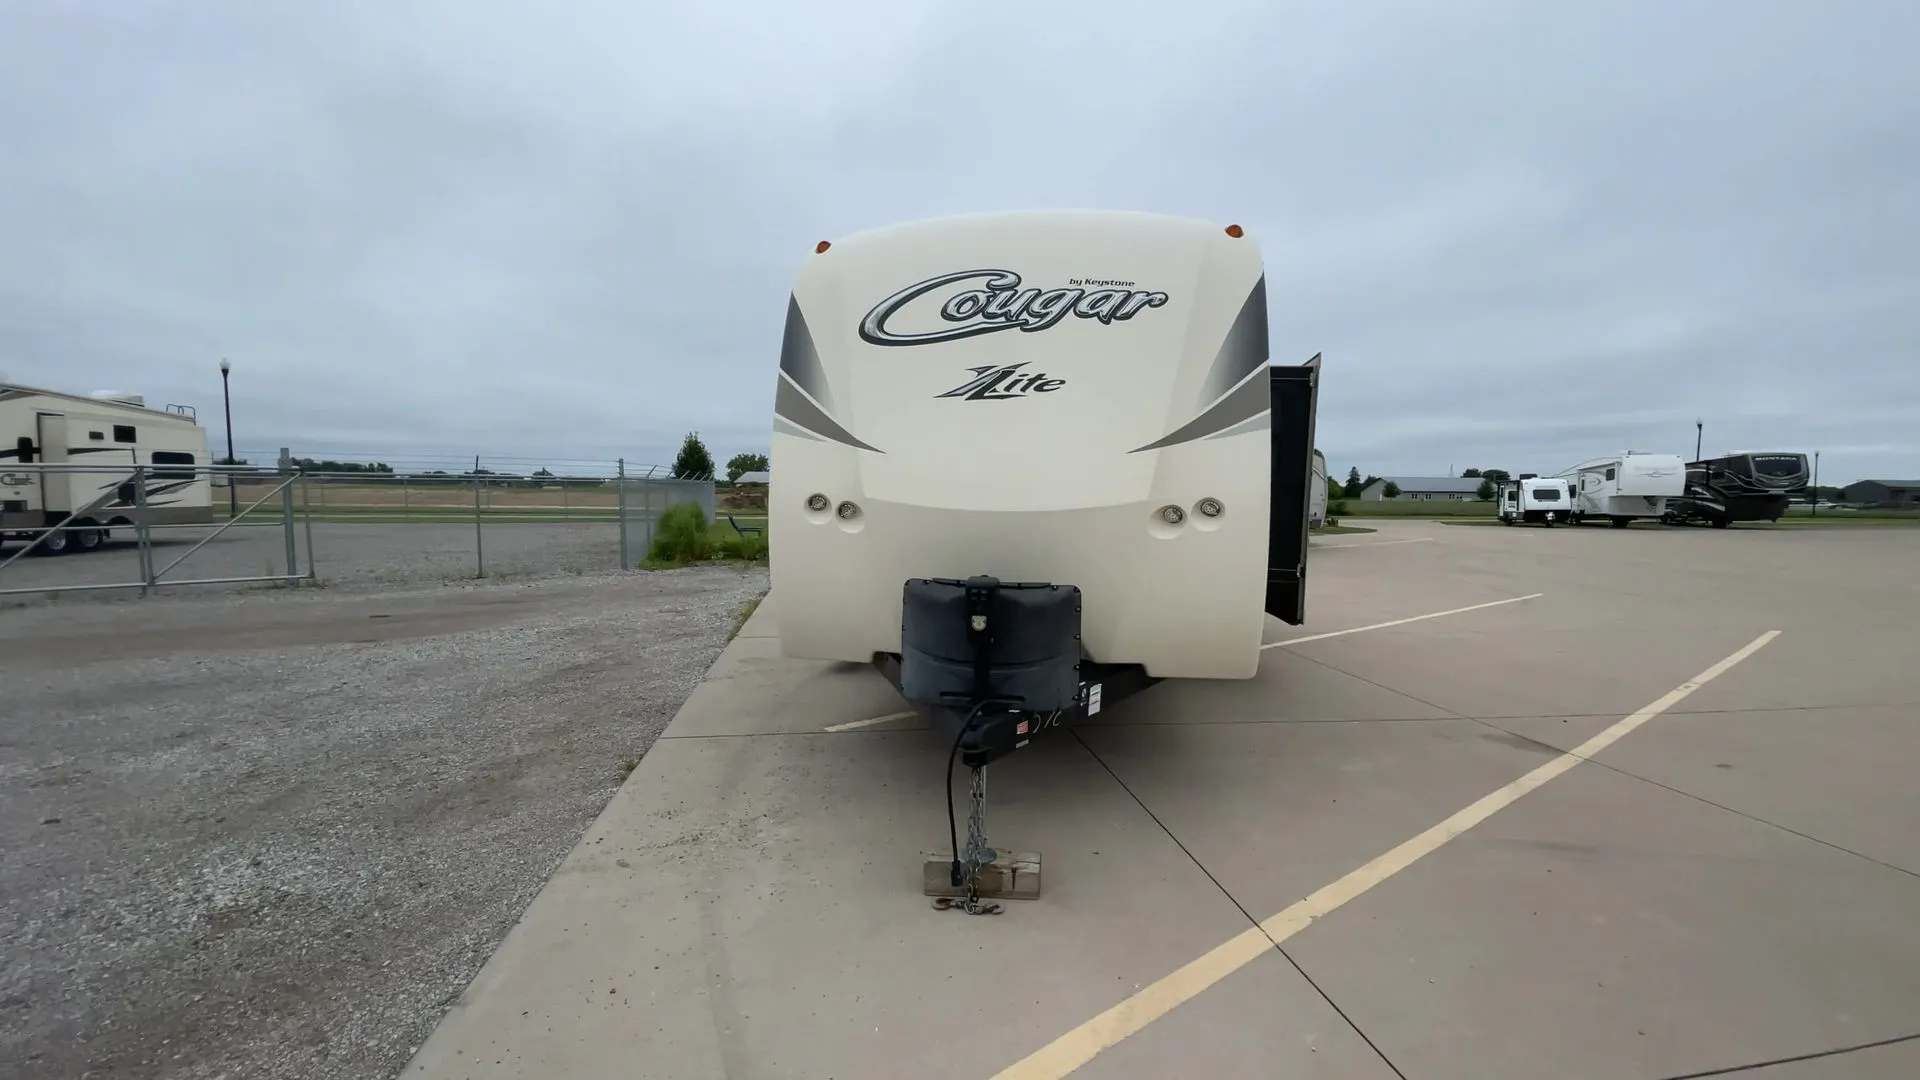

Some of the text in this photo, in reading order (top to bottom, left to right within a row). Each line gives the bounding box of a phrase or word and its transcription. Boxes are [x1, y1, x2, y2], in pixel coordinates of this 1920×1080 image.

[1069, 278, 1136, 287] by Keystone
[858, 268, 1169, 347] Cougar
